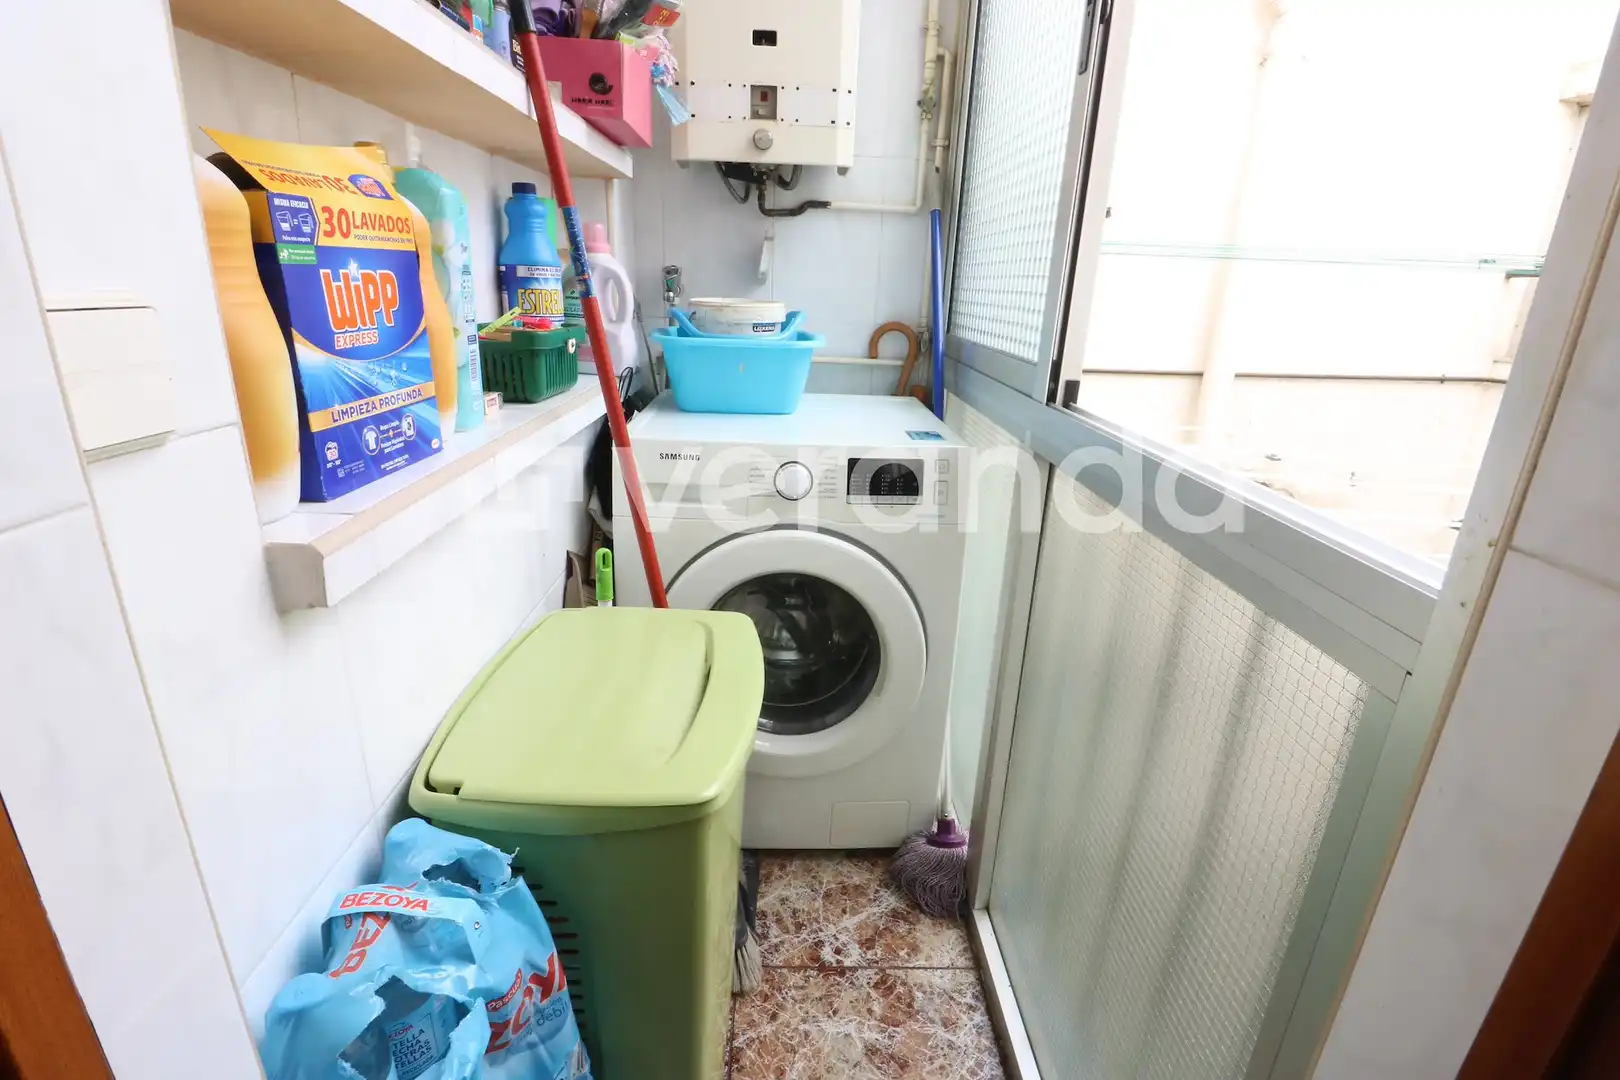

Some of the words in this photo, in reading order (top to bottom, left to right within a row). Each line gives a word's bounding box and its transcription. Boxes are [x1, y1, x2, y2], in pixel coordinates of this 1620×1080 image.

[321, 205, 351, 239] 30
[352, 210, 411, 234] LAVADOS
[335, 333, 378, 349] EXPRESS
[331, 401, 377, 424] LIMPIEZA
[379, 388, 422, 409] PROFUNDA
[659, 452, 700, 461] SAMSUNG
[340, 891, 429, 911] BEZOYA
[395, 1039, 430, 1063] OTRAS
